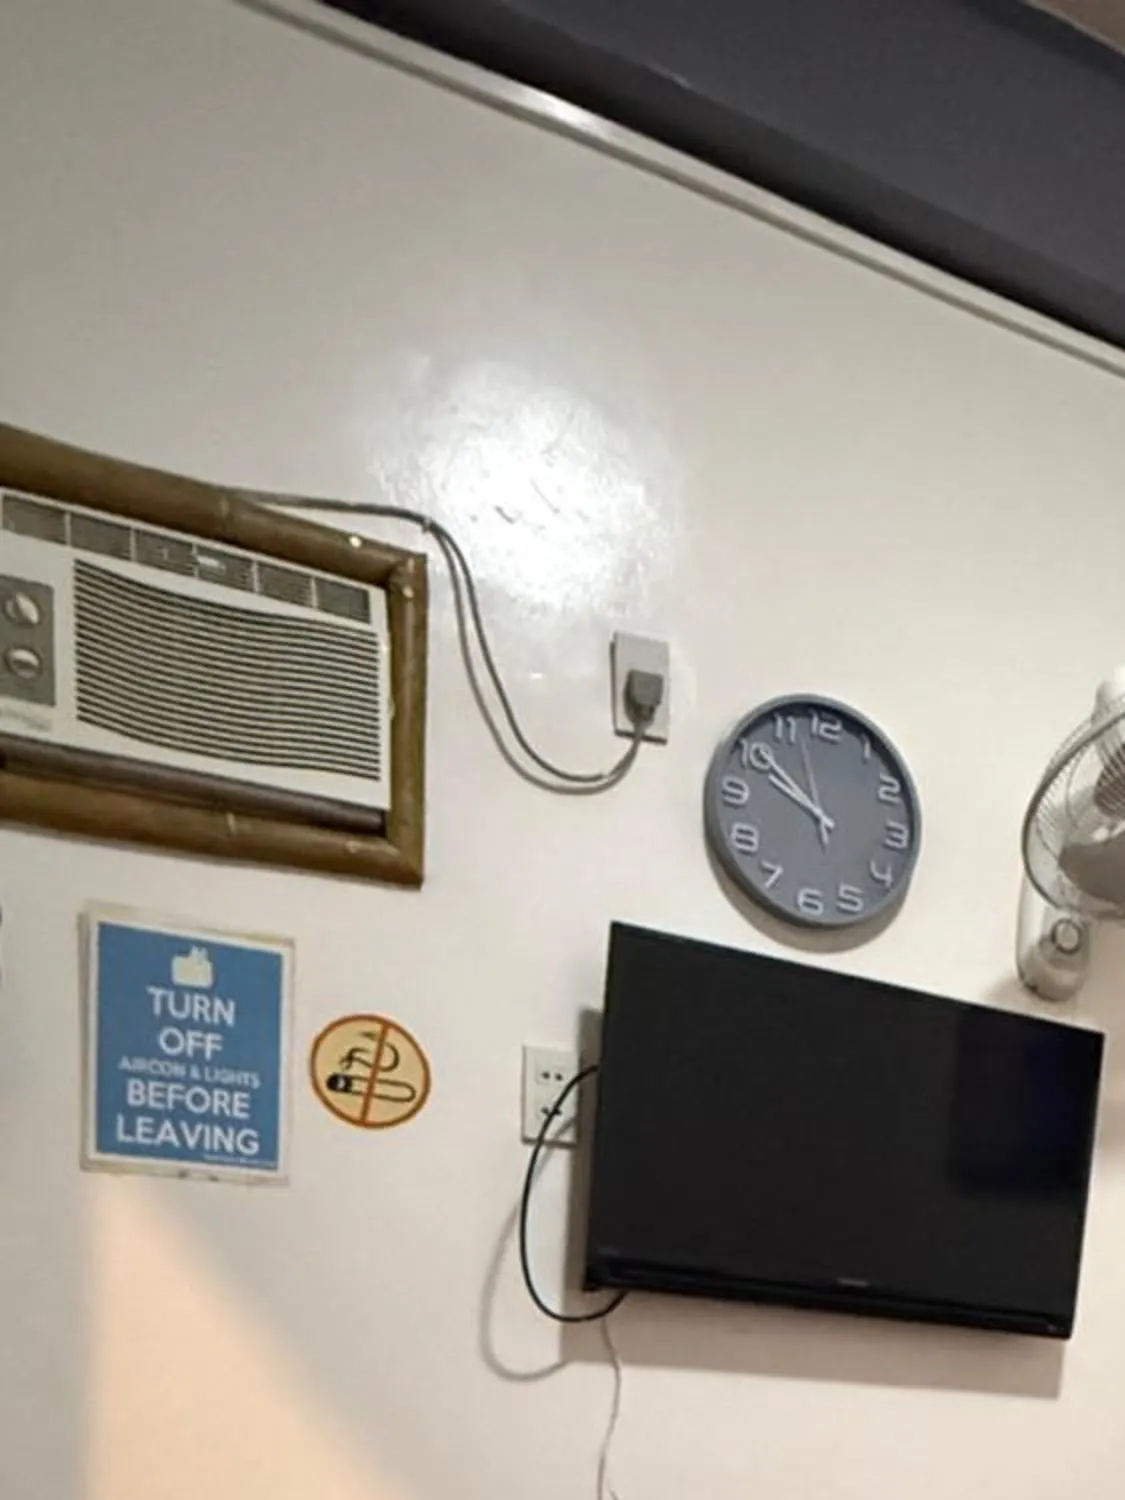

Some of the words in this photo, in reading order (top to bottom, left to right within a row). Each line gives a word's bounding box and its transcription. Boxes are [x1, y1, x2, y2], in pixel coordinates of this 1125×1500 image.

[775, 714, 797, 742] 11
[811, 711, 842, 740] 12
[741, 739, 773, 770] 10
[862, 735, 873, 759] 1
[722, 777, 750, 806] 9
[877, 774, 901, 801] 2
[732, 823, 760, 852] 8
[885, 821, 909, 850] 3
[761, 861, 784, 888] 7
[870, 858, 893, 888] 4
[798, 887, 824, 916] 6
[837, 883, 864, 912] 5
[147, 987, 236, 1027] TURN
[159, 1027, 223, 1060] OFF
[118, 1056, 186, 1077] AIRCON
[204, 1068, 261, 1089] LIGHTS
[127, 1078, 251, 1119] BEFORE
[116, 1114, 260, 1155] LEAVING
